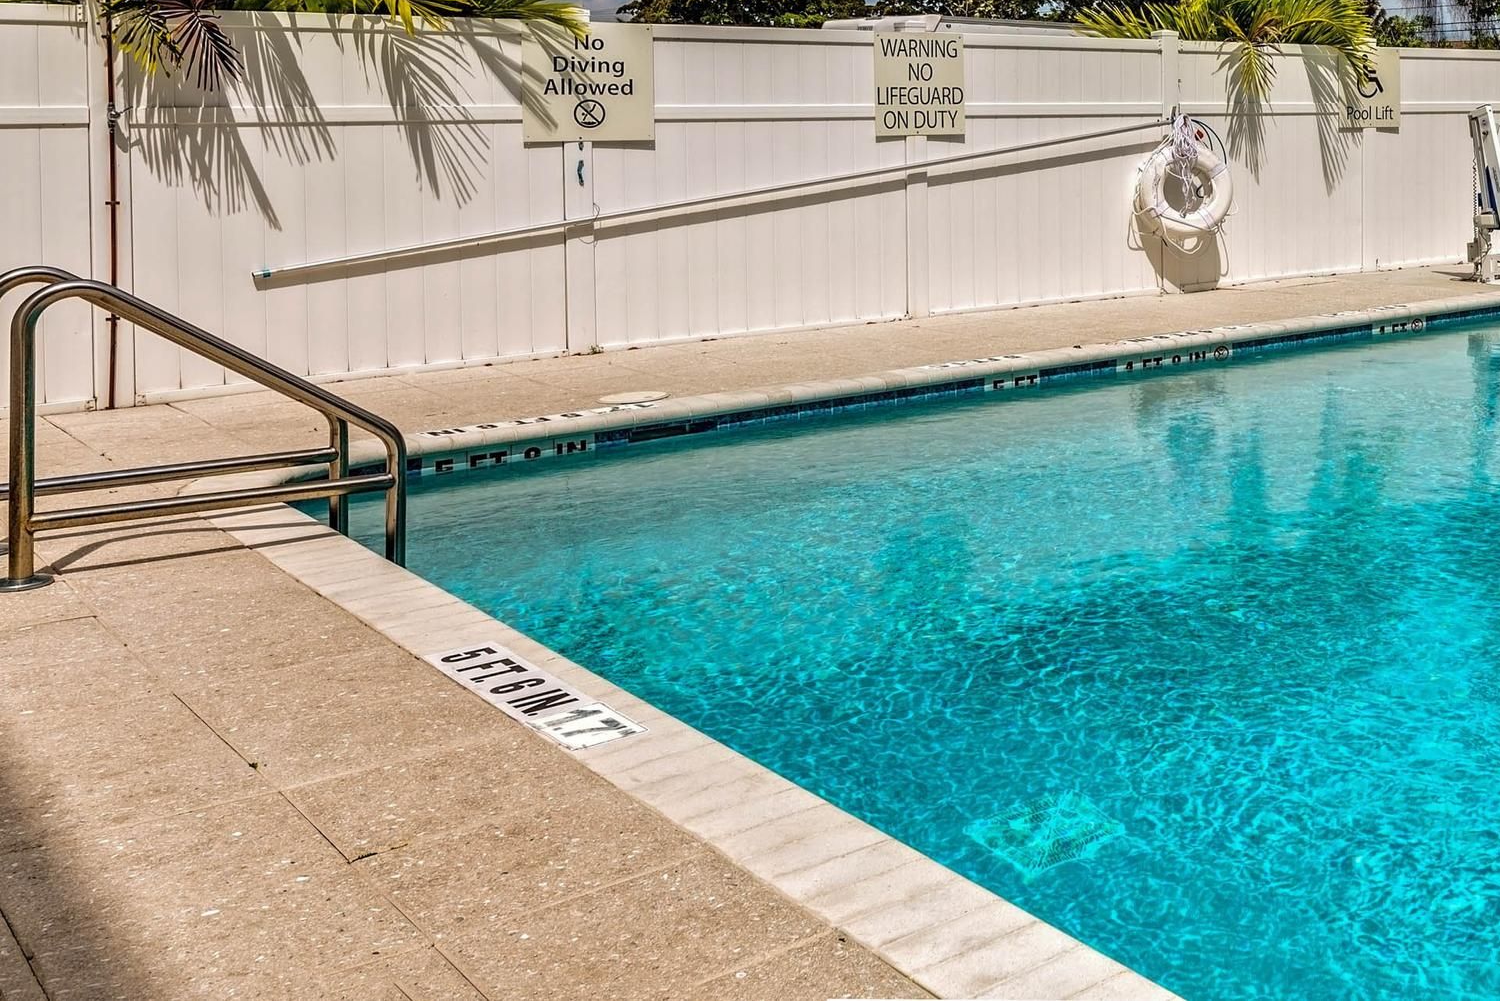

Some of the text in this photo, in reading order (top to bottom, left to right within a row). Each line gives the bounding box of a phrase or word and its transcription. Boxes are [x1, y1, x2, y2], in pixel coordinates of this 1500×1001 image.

[574, 34, 605, 51] No
[880, 38, 958, 58] WARNING
[553, 56, 625, 77] Diving
[908, 62, 933, 82] NO
[543, 78, 634, 96] Allowed
[877, 86, 964, 105] LIFEGUARD
[883, 110, 958, 129] ON DUTY
[1346, 105, 1394, 120] Pool Lift
[440, 646, 498, 663] 5
[456, 658, 529, 684] FT.
[489, 678, 546, 695] 6
[506, 688, 580, 717] IN.
